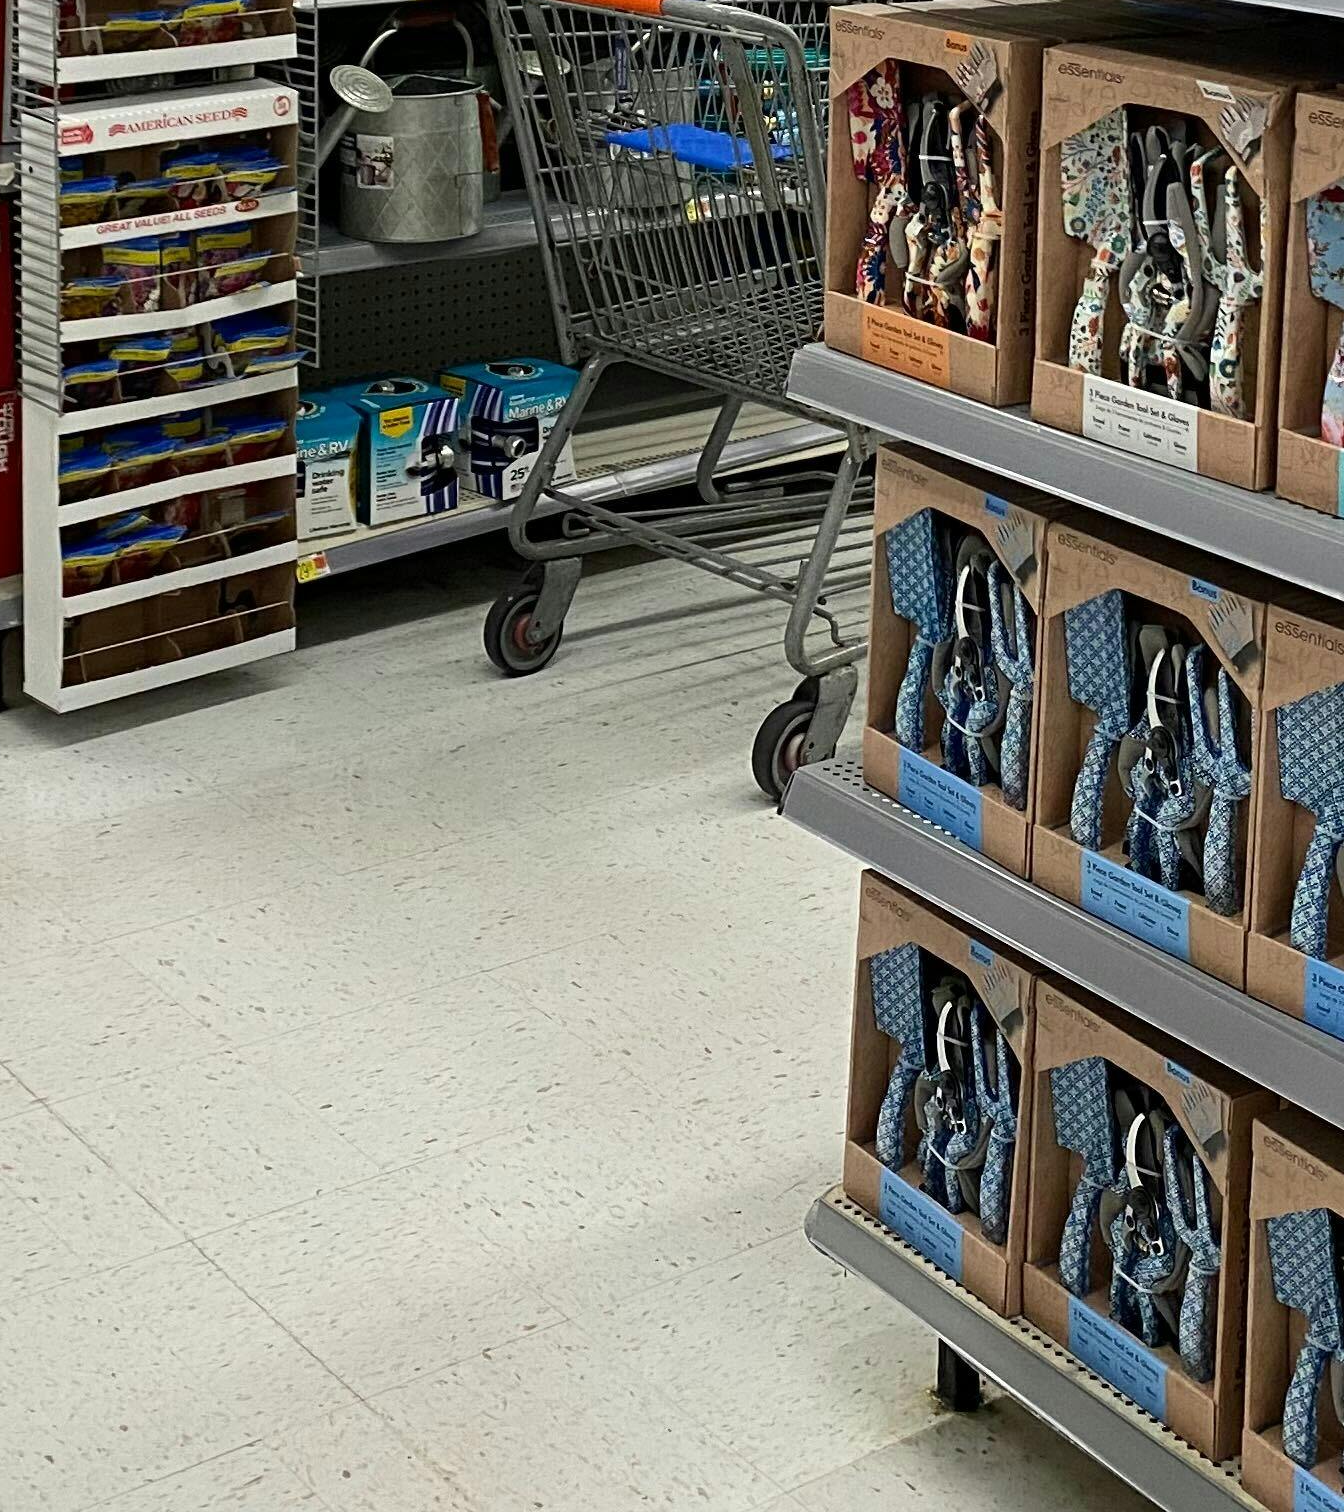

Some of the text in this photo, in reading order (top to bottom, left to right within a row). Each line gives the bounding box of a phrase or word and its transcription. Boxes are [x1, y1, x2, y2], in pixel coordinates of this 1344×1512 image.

[1058, 63, 1124, 84] essentials
[125, 110, 232, 134] AMERICAN SEED
[508, 403, 545, 420] Marine
[545, 401, 554, 413] &
[316, 442, 329, 456] &
[330, 440, 348, 454] RV
